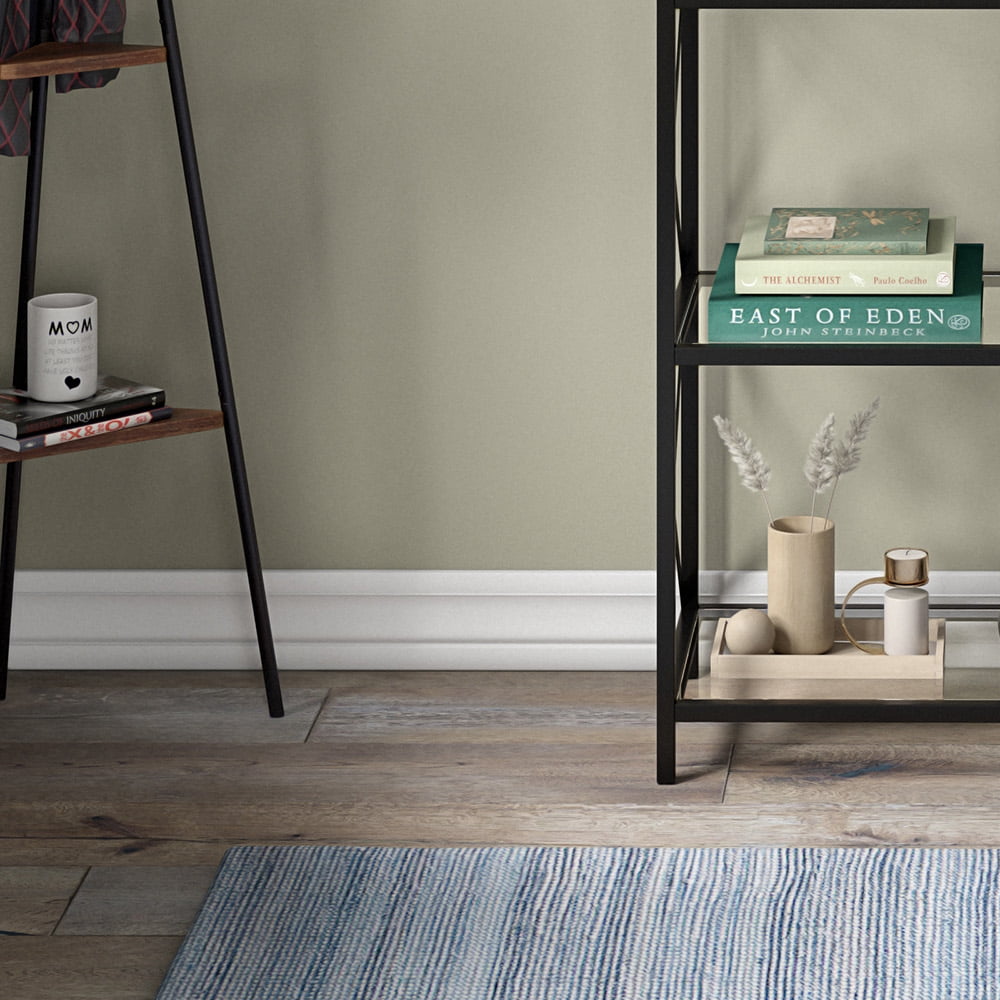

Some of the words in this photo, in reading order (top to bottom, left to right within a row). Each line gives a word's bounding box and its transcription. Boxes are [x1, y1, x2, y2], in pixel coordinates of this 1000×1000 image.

[762, 275, 782, 285] THE
[785, 275, 842, 285] ALCHEMIST
[873, 275, 896, 286] Paulo
[898, 275, 928, 286] Coelho
[729, 307, 802, 325] EAST
[815, 307, 852, 325] OF
[866, 307, 945, 325] EDEN
[761, 327, 813, 339] JOHN
[820, 327, 927, 337] STEINBECK
[66, 407, 106, 425] INIQUITY
